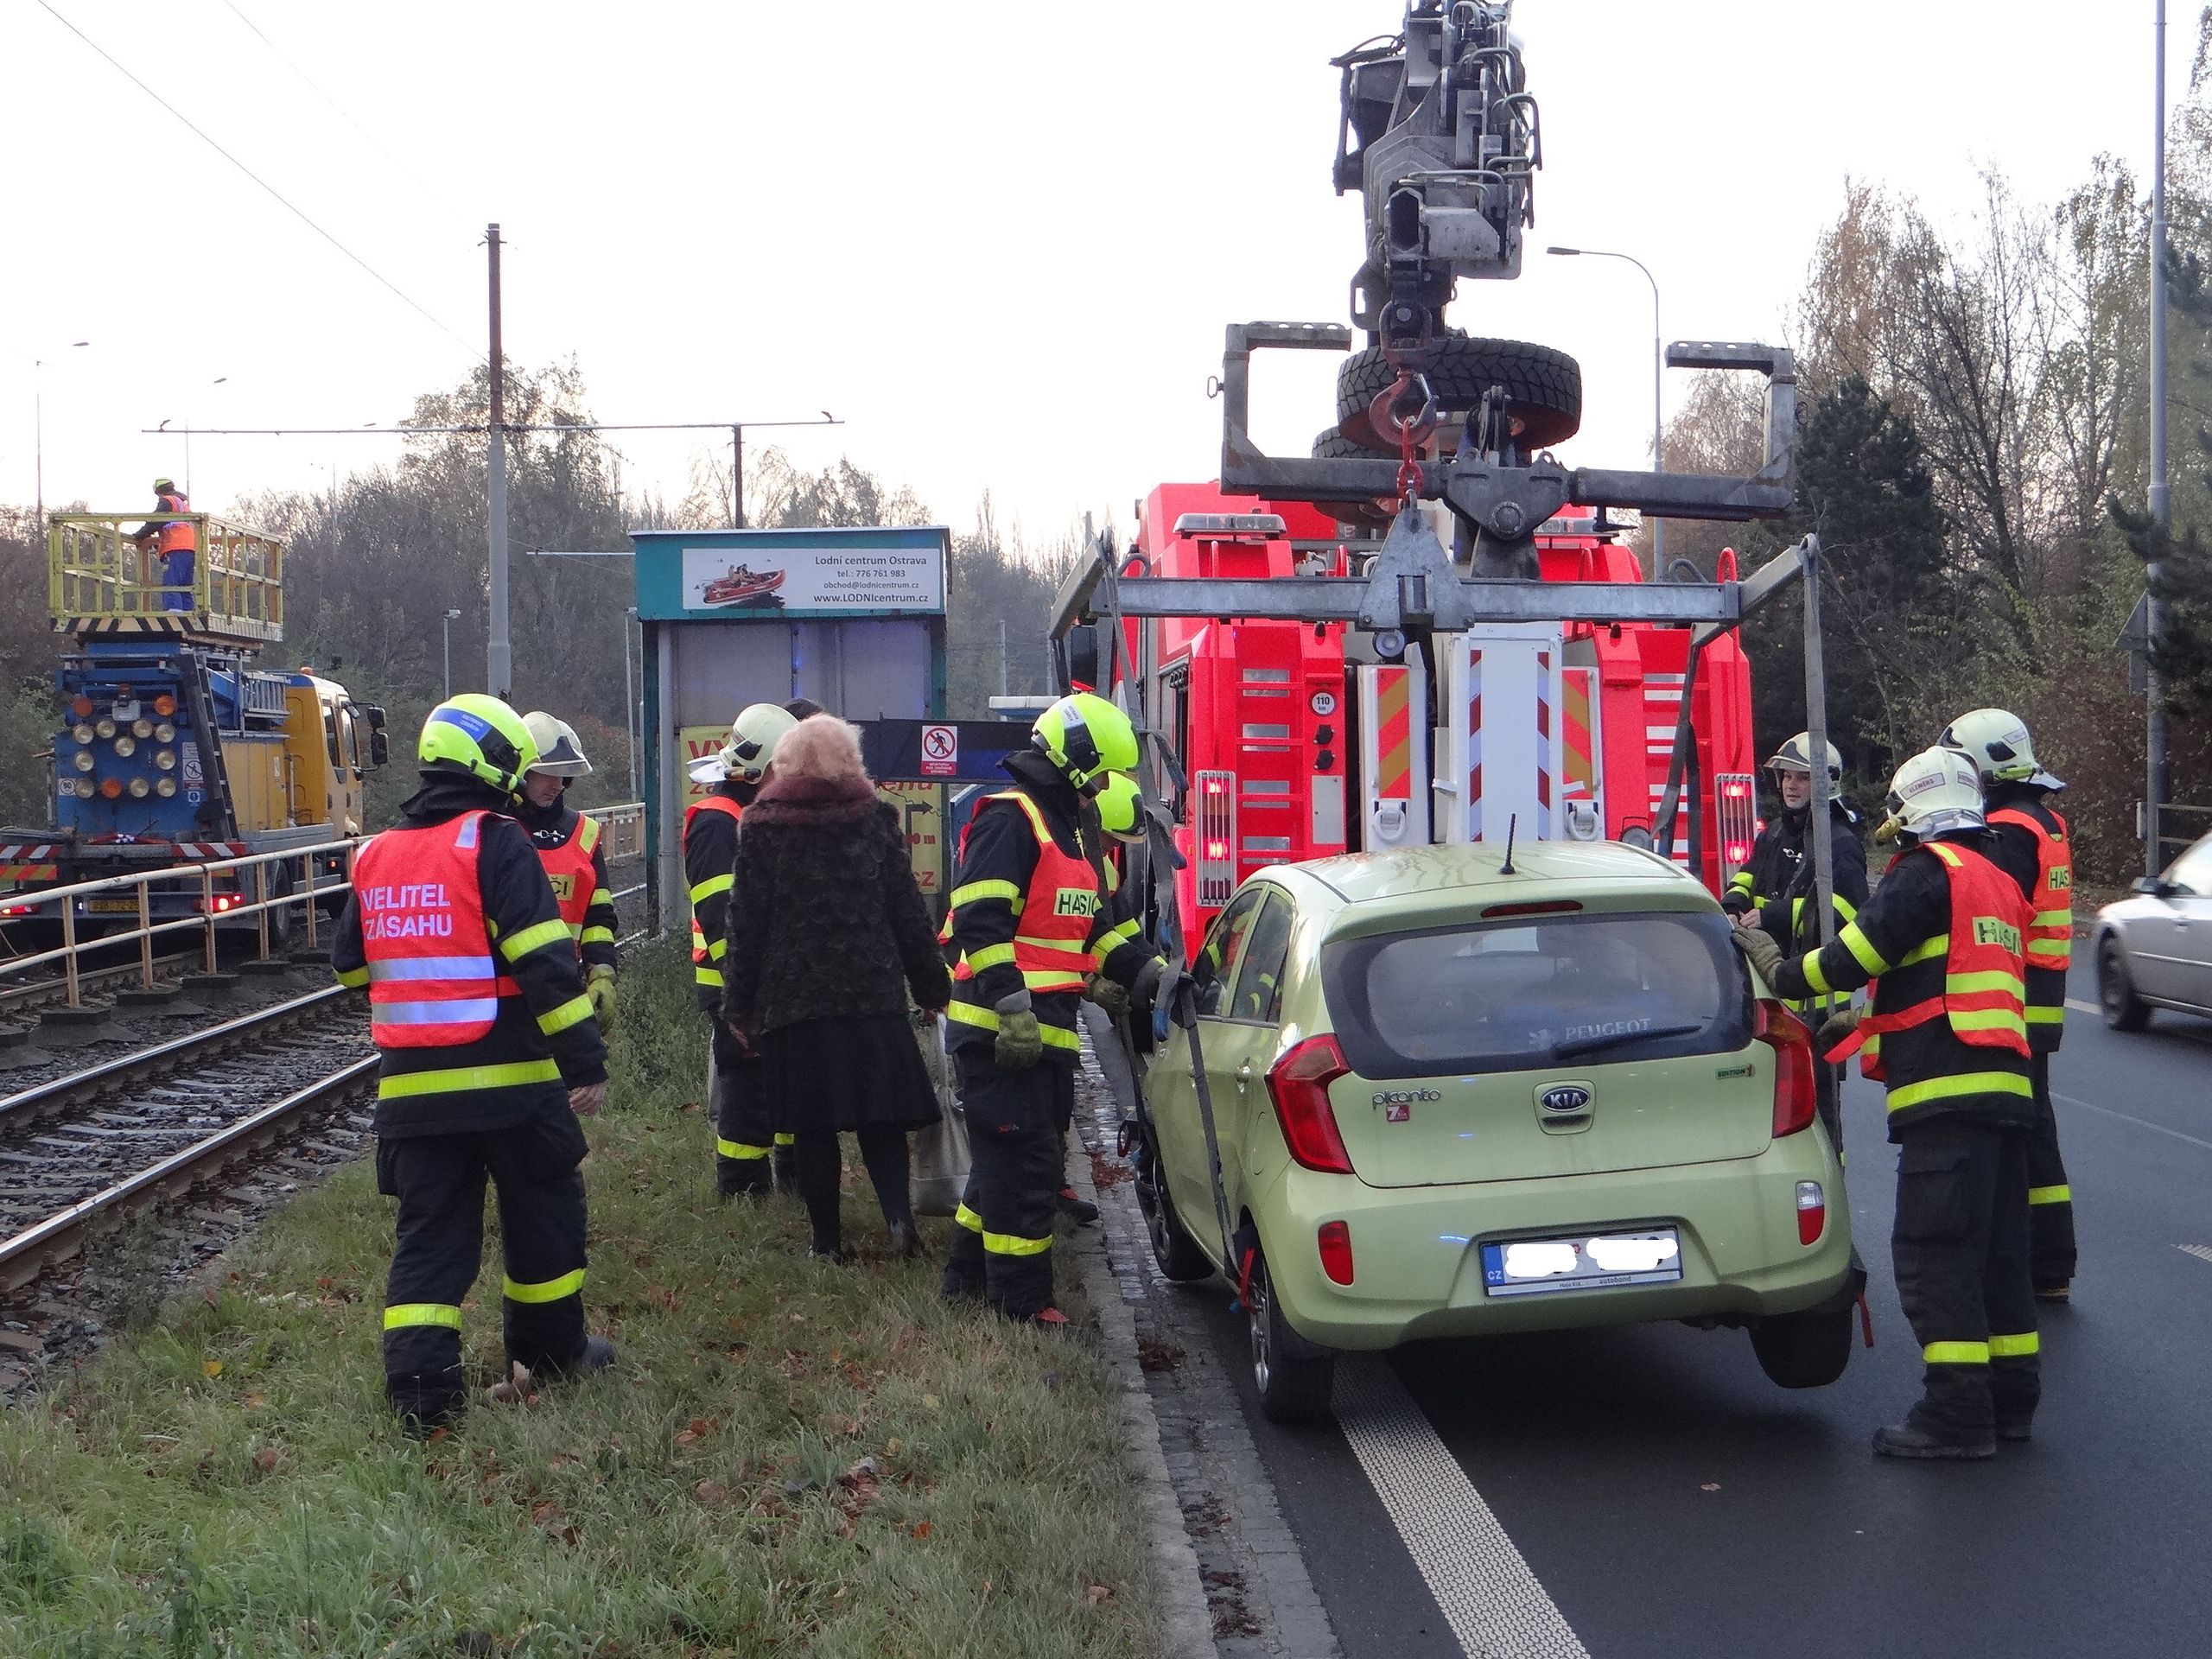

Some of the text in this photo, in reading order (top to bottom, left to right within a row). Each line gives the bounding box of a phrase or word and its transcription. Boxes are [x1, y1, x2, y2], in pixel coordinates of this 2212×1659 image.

[815, 556, 842, 565] Lodní
[889, 556, 927, 565] Ostrava
[1316, 696, 1330, 705] 110
[361, 883, 451, 912] VELITEL
[364, 912, 453, 940] ZÁSAHU
[1565, 1018, 1651, 1040] PEUGEOT
[1717, 1068, 1745, 1077] EDITION
[1371, 1086, 1441, 1112] picanto
[1549, 1091, 1583, 1108] KIA
[1387, 1105, 1401, 1121] 7
[1487, 1270, 1503, 1281] CZ
[1599, 1275, 1632, 1285] autobond
